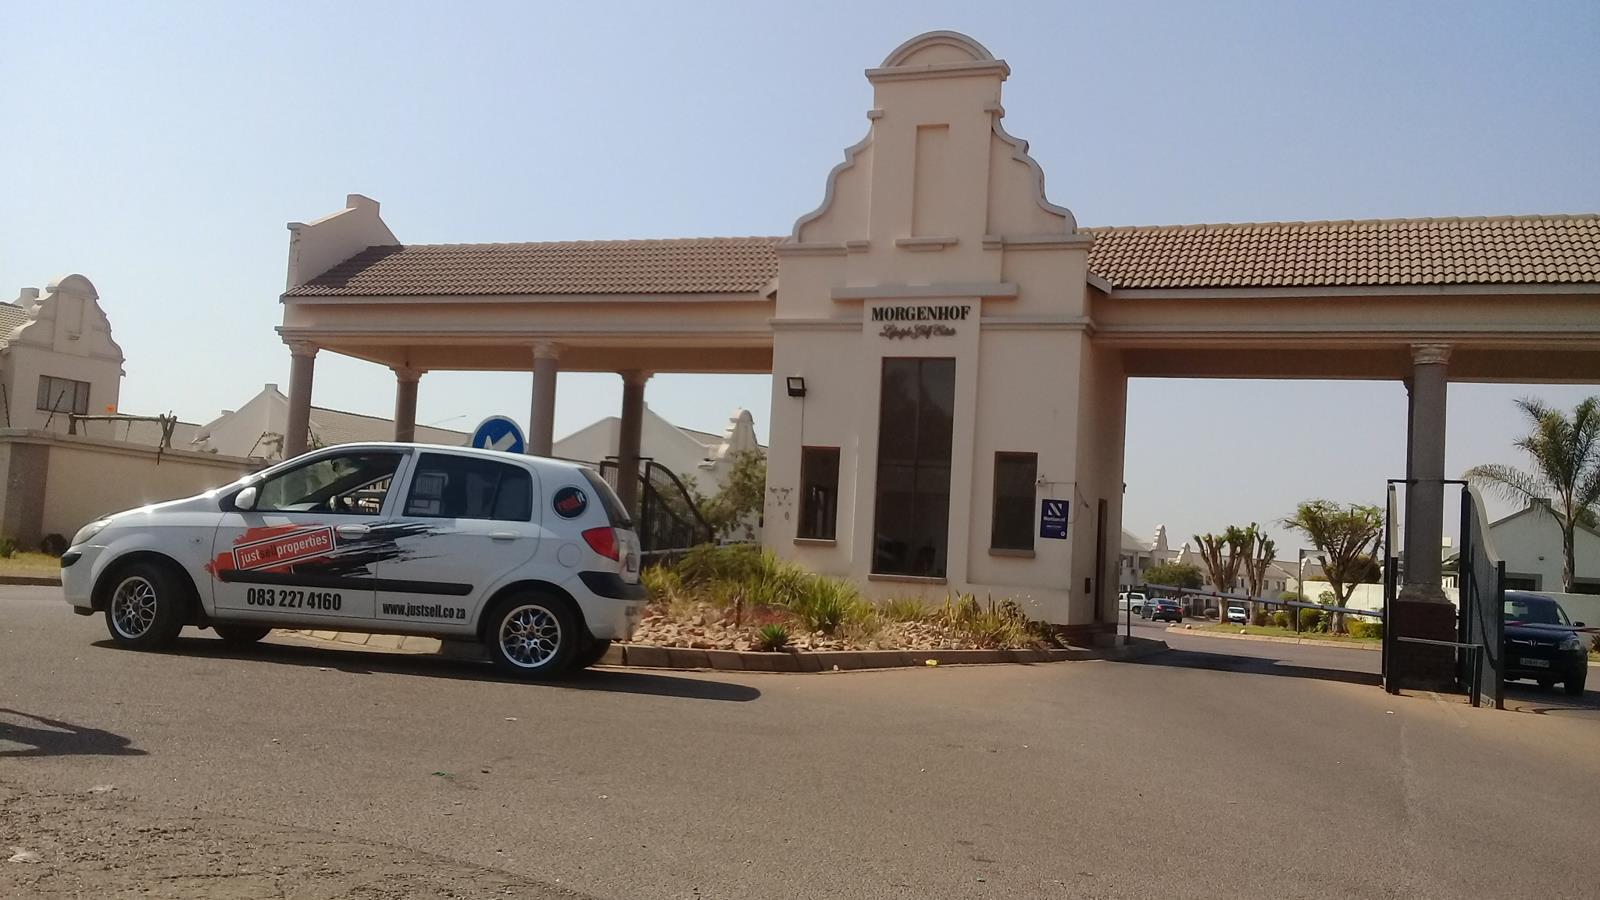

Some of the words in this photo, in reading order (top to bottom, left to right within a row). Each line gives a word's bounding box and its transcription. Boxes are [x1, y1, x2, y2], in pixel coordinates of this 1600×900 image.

[871, 305, 971, 321] MORGENHOF
[247, 588, 275, 606] 083
[279, 590, 304, 608] 227
[307, 592, 342, 611] 4160
